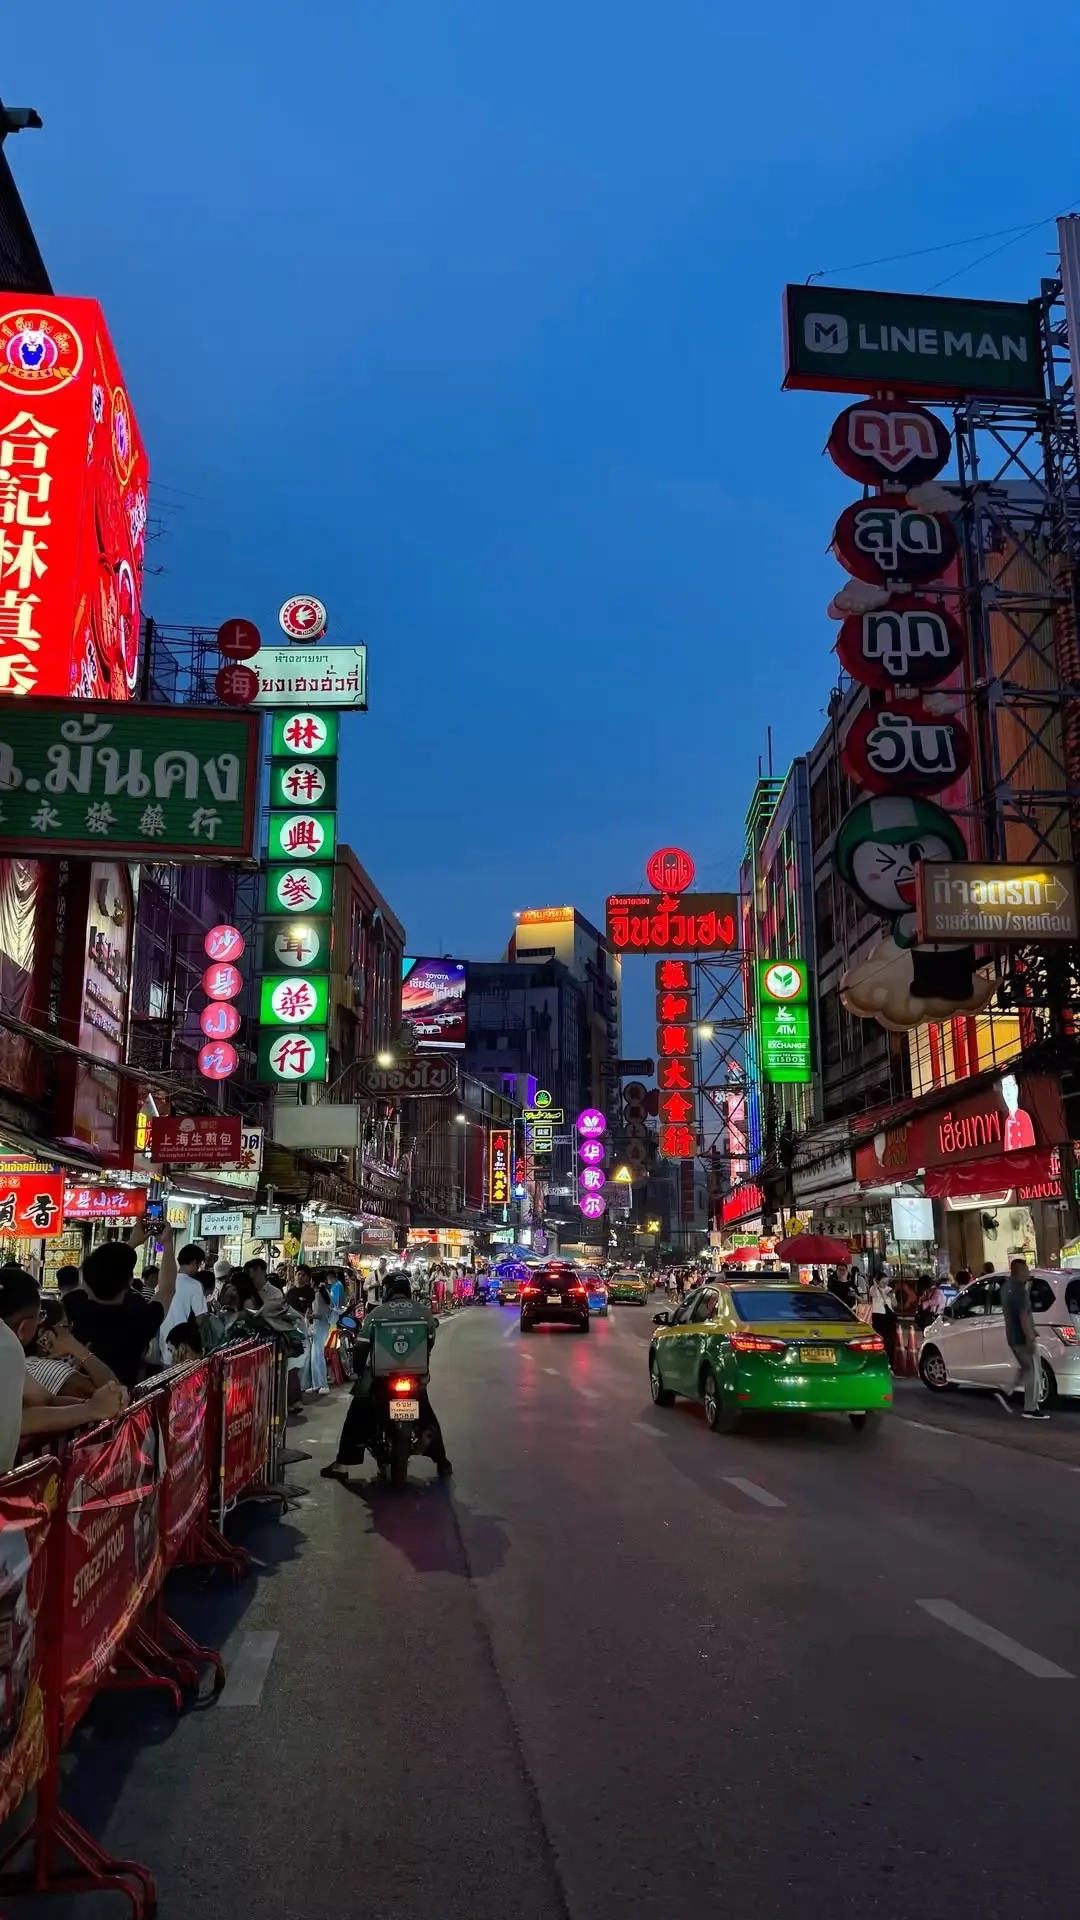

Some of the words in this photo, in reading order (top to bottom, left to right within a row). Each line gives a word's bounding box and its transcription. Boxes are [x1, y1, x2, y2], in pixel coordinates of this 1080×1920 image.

[858, 323, 938, 355] LINE
[944, 331, 1028, 362] MAN
[854, 508, 942, 571] สุด
[862, 611, 950, 676] ทุก
[866, 712, 956, 773] วัน
[0, 799, 223, 841] 永發藥行
[933, 868, 1041, 905] ที่จอดรถ
[203, 930, 240, 1073] 沙县小吃
[775, 1025, 797, 1034] ATM
[160, 1132, 233, 1147] 上海生煎包
[938, 1111, 1001, 1154] เฮียเทพ
[584, 1144, 601, 1214] 华歌尔
[72, 1548, 107, 1608] STREET
[106, 1524, 125, 1569] FOOD
